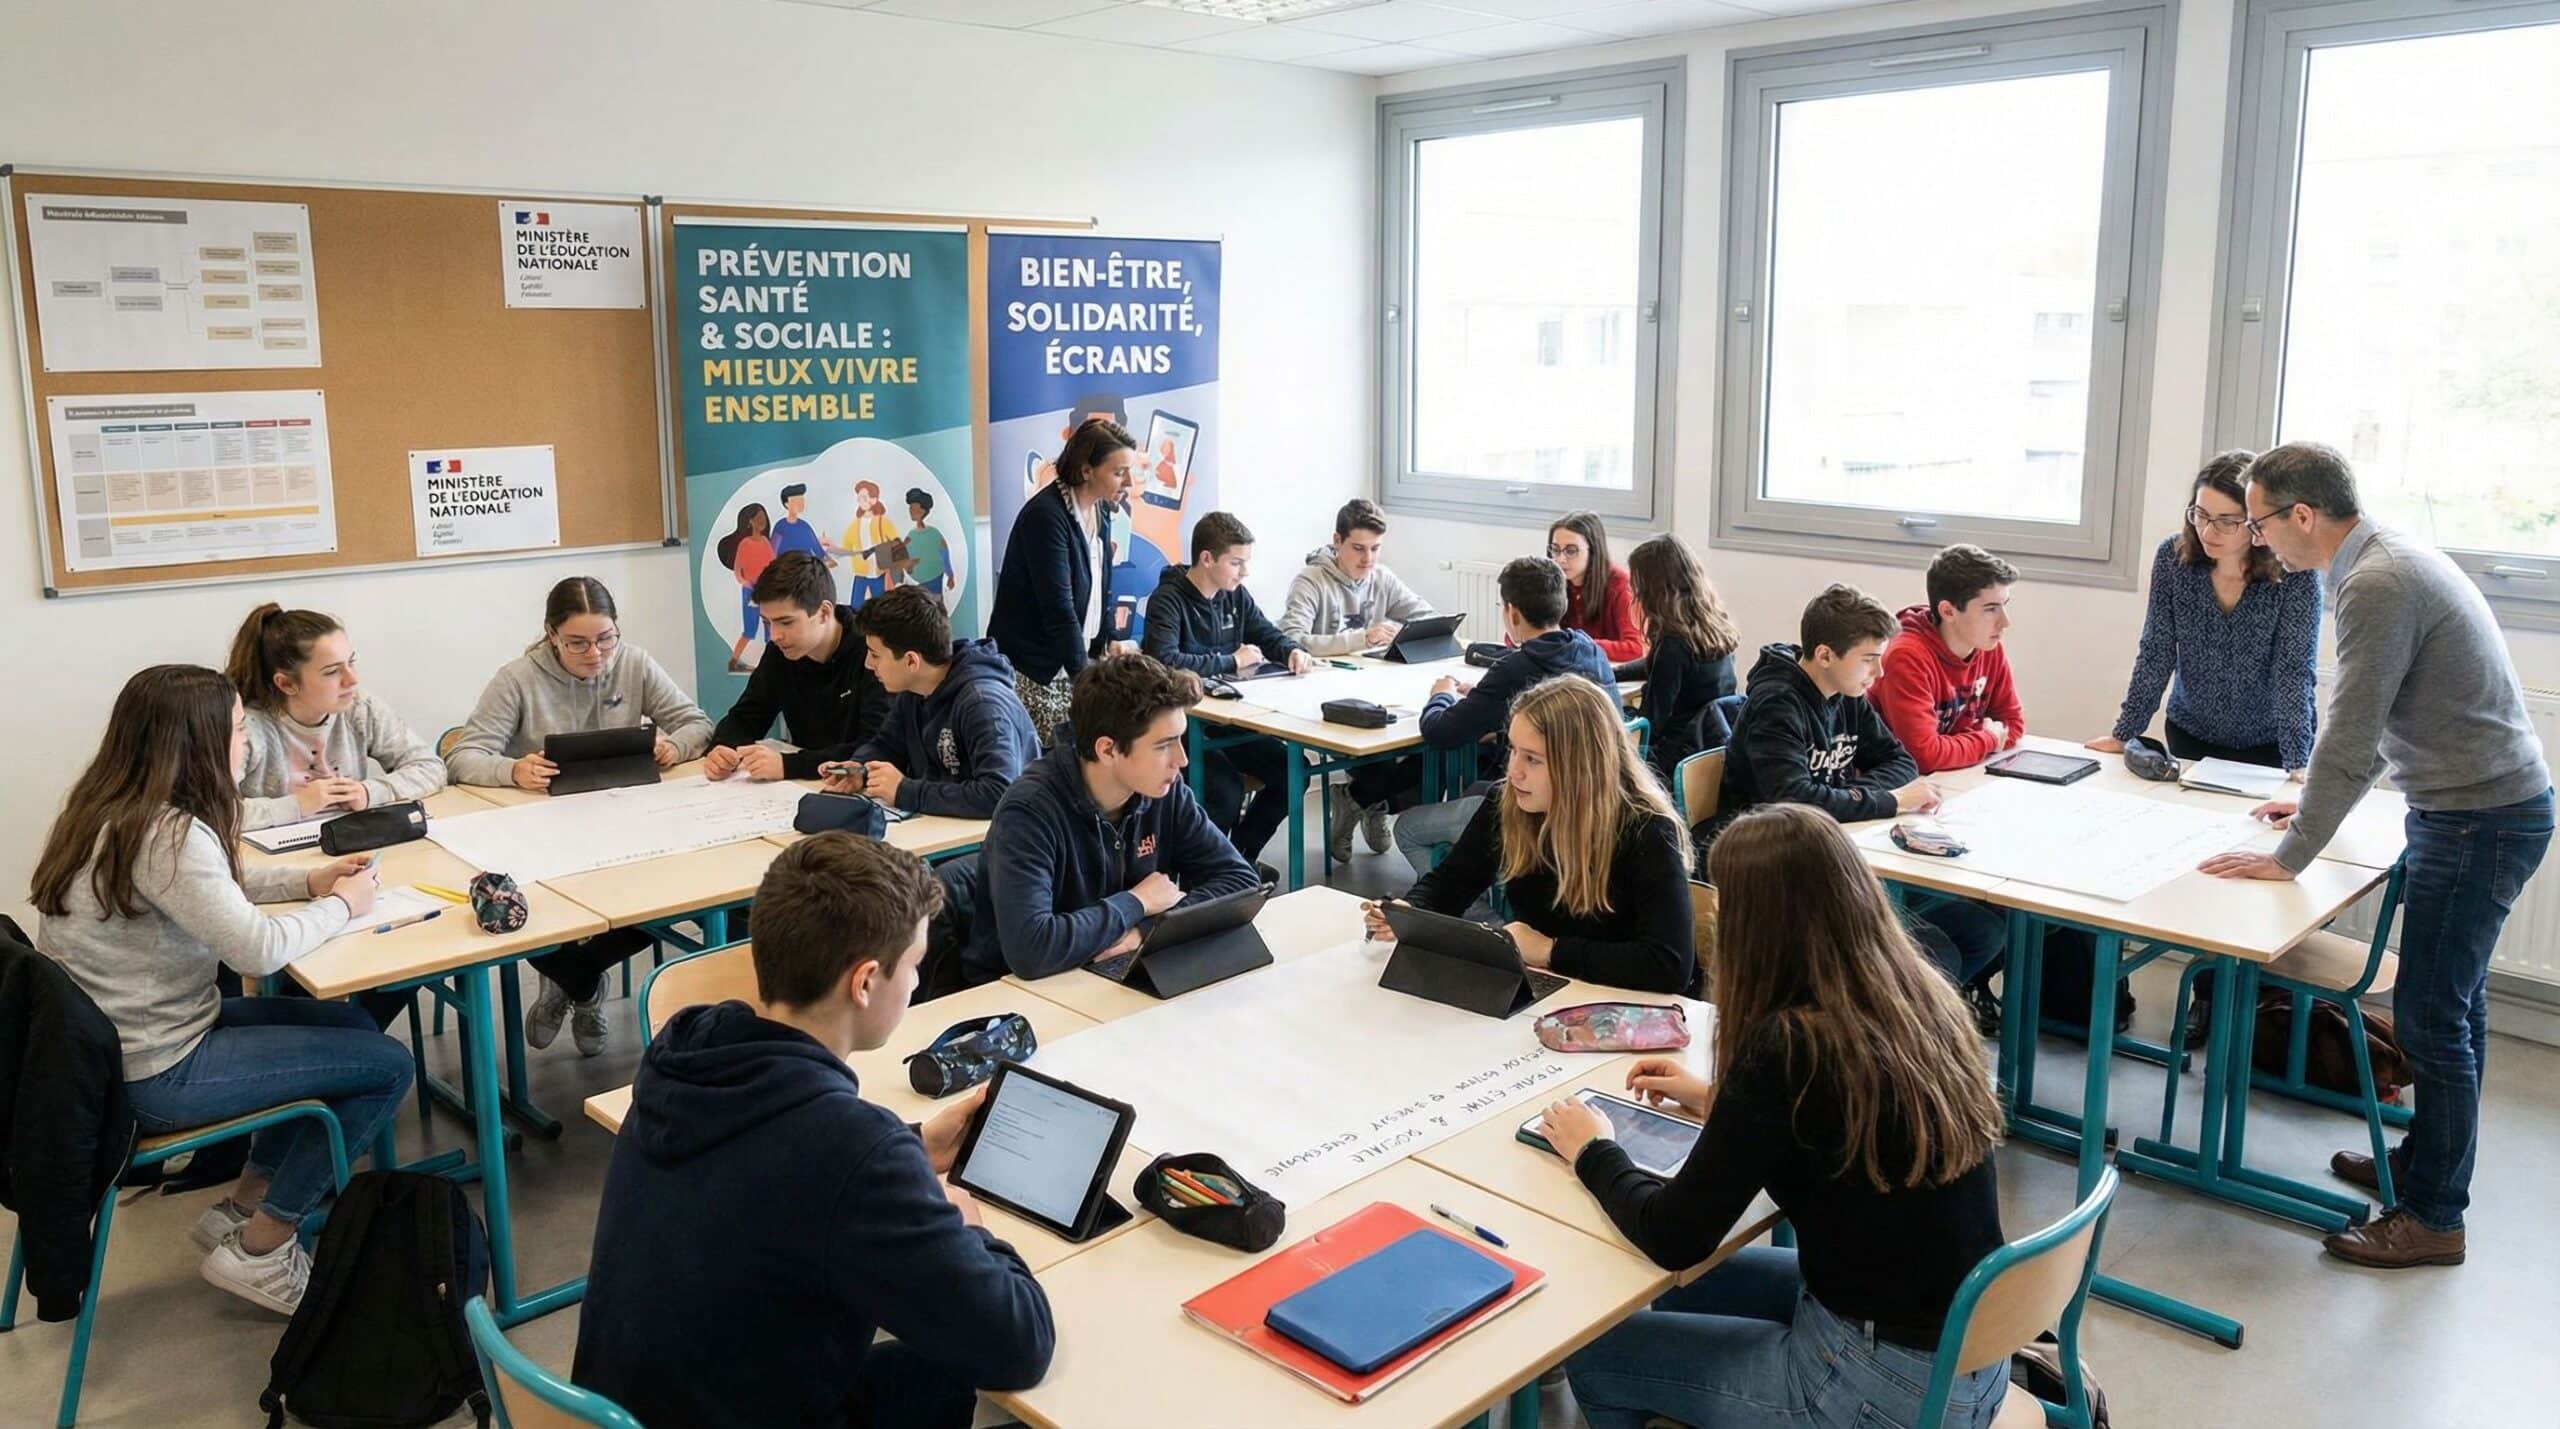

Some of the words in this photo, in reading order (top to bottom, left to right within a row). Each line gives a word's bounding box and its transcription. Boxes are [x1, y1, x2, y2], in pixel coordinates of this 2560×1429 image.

[516, 228, 590, 243] MINISTÈRE
[517, 244, 535, 256] DE
[518, 258, 599, 270] NATIONALE
[698, 243, 911, 278] PRÉVENTION
[1021, 251, 1192, 295] BIEN-ÊTRE,
[699, 280, 809, 313] SANTÉ
[1007, 296, 1203, 337] SOLIDARITÉ,
[701, 322, 726, 349] &
[734, 321, 873, 349] SOCIALE
[1046, 338, 1171, 375] ÉCRANS
[703, 358, 813, 386] MIEUX
[820, 358, 918, 384] VIVRE
[705, 393, 875, 423] ENSEMBLE
[427, 475, 503, 490] MINISTÈRE
[429, 492, 447, 504] DE
[430, 502, 511, 518] NATIONALE
